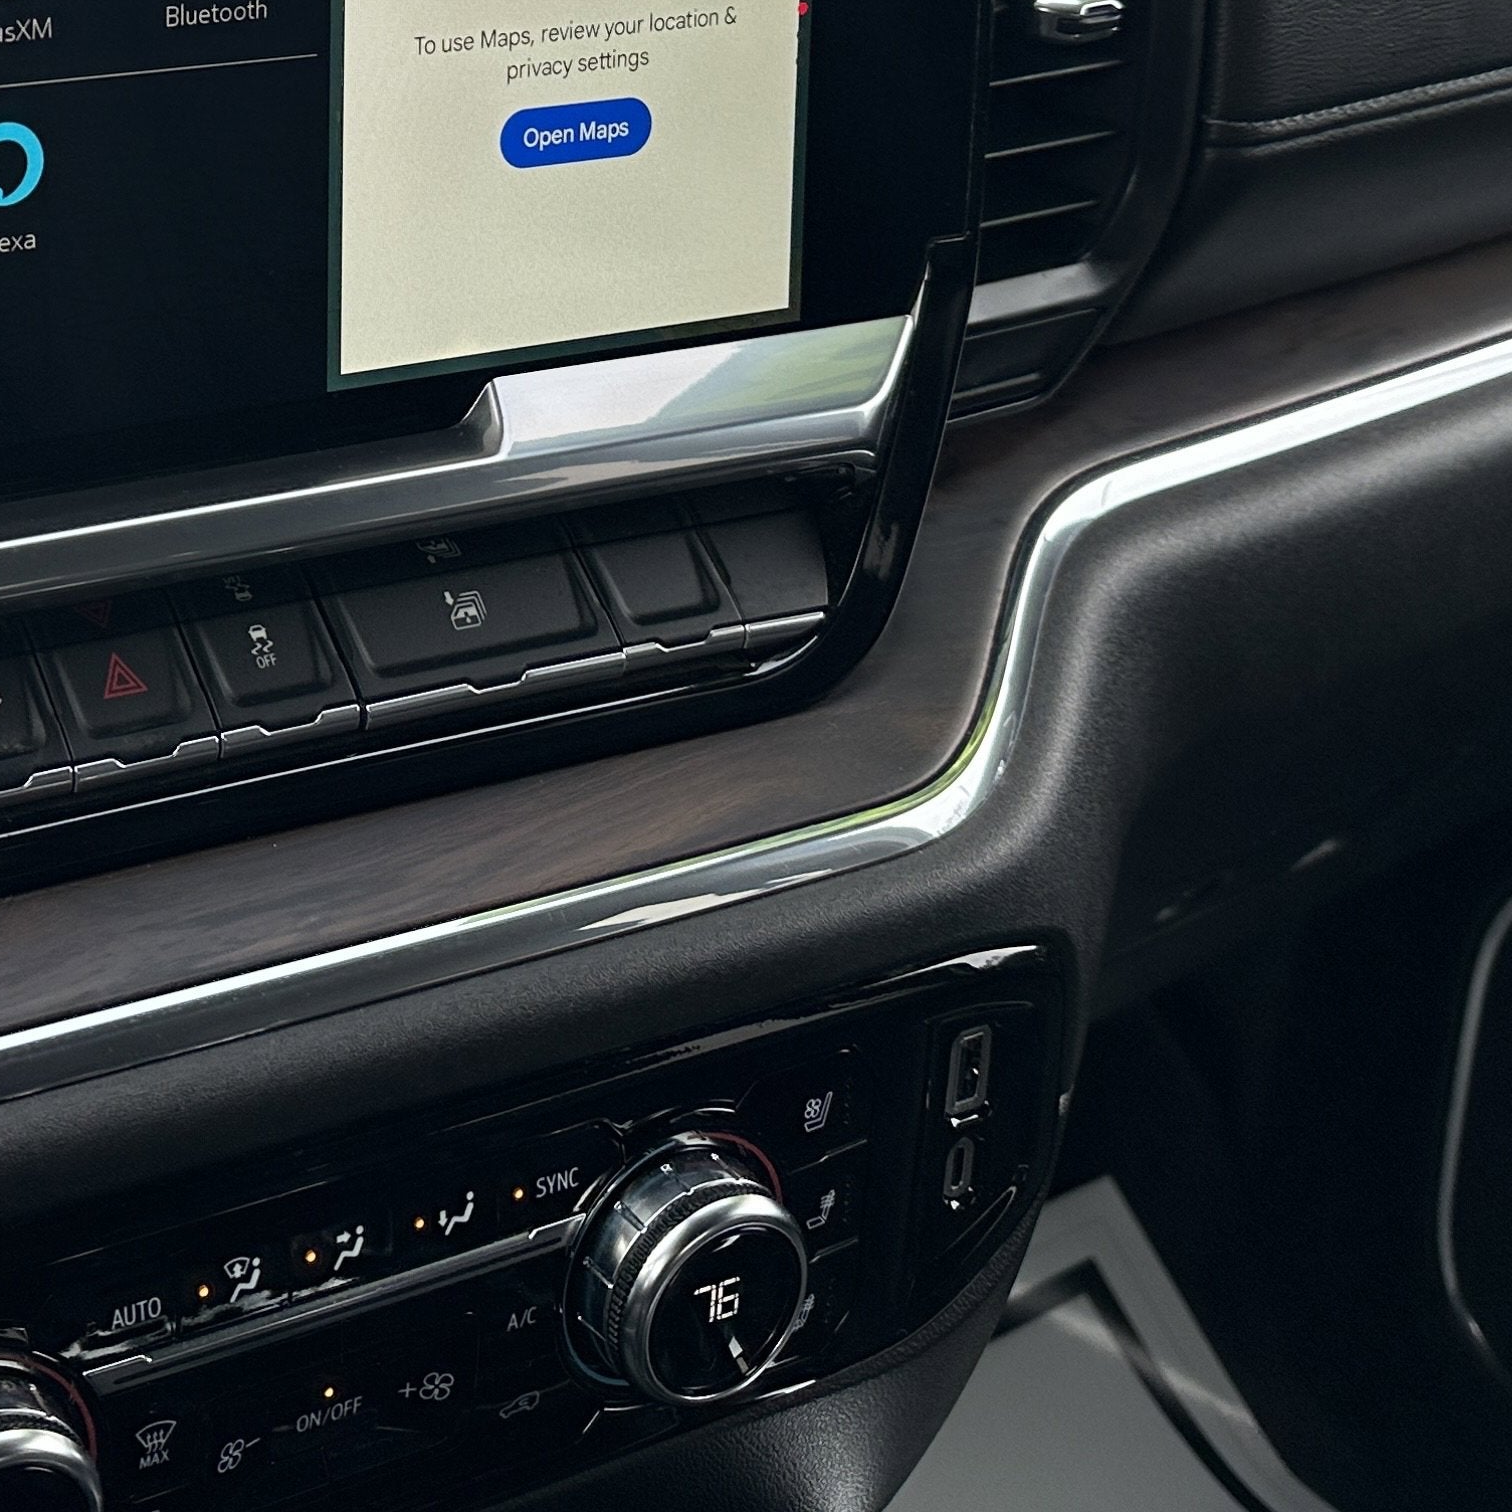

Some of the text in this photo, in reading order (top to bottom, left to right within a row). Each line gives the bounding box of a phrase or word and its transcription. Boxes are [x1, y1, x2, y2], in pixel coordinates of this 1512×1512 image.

[414, 5, 737, 56] To use Maps, review your location &
[507, 48, 650, 85] privacy settings
[523, 120, 629, 151] Open Maps
[256, 652, 277, 669] OFF
[536, 1167, 579, 1198] SYNC
[112, 1298, 162, 1329] AUTO
[694, 1276, 740, 1323] 76
[506, 1306, 537, 1332] A/C
[297, 1396, 363, 1433] ON/OFF
[139, 1448, 170, 1470] MAX
